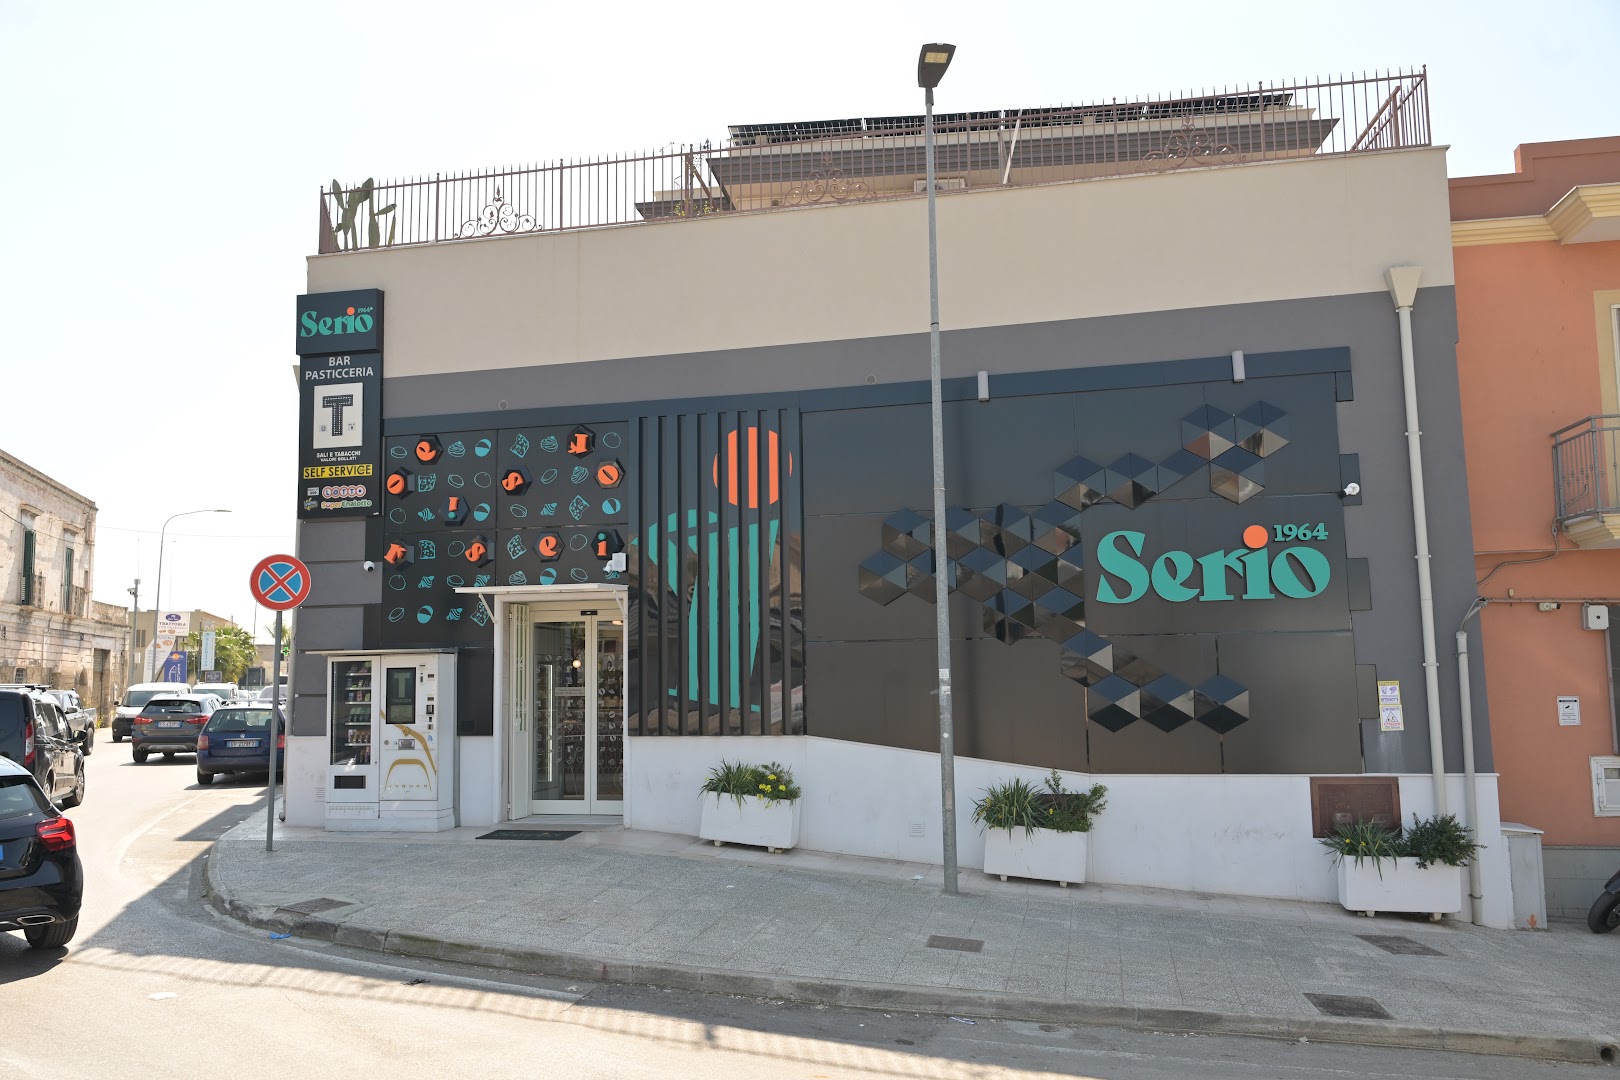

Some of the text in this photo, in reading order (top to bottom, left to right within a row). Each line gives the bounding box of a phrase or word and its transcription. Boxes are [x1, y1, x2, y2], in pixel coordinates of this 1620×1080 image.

[300, 307, 374, 338] Serio
[329, 356, 351, 367] BAR
[305, 367, 374, 381] PASTICCERIA
[322, 394, 354, 437] T
[304, 465, 371, 478] SELF SERVICE
[320, 499, 373, 510] SuperEnalotto
[1273, 522, 1329, 543] 1964
[1096, 524, 1332, 604] Serio
